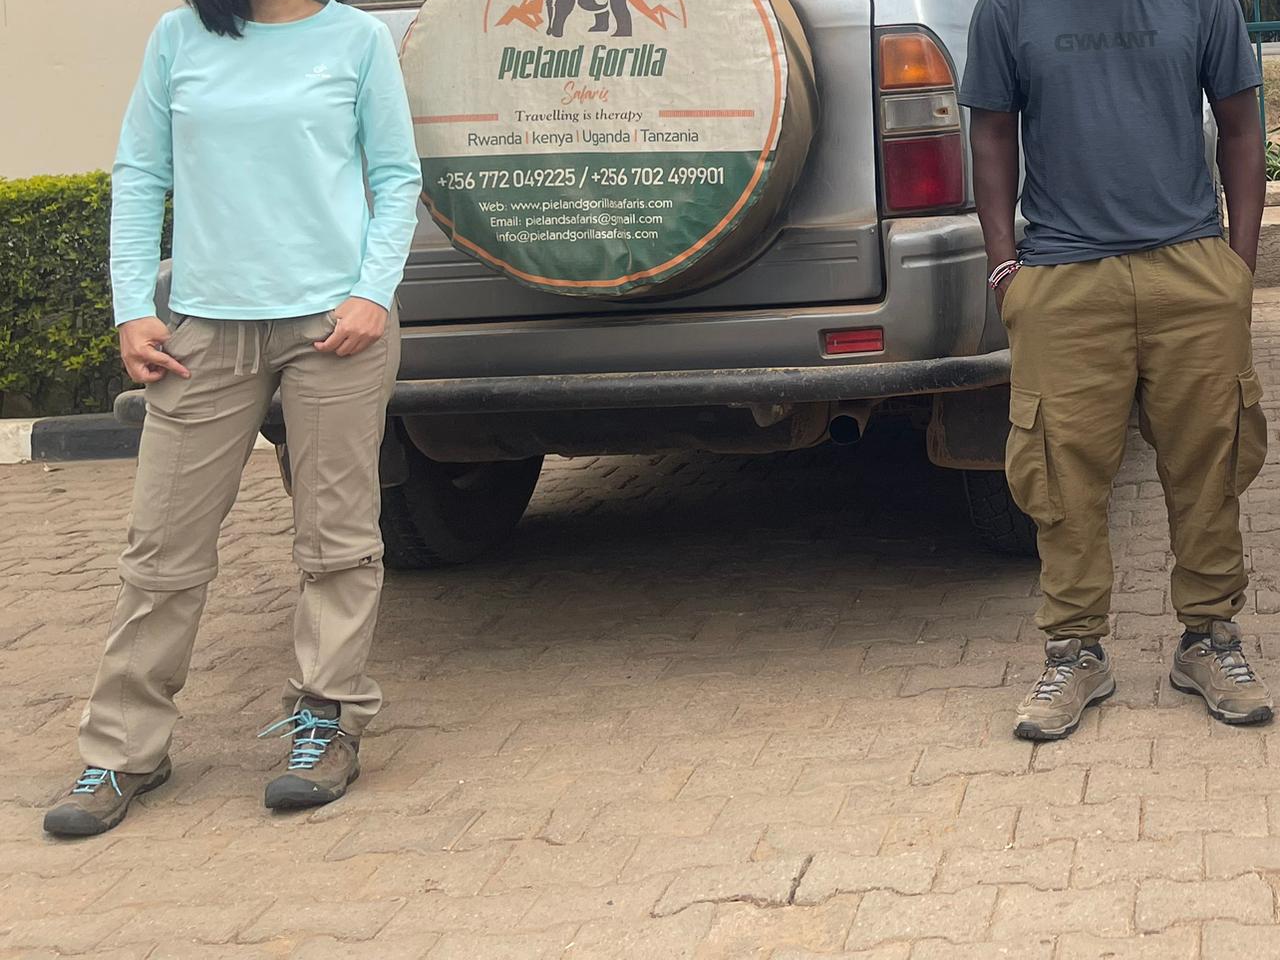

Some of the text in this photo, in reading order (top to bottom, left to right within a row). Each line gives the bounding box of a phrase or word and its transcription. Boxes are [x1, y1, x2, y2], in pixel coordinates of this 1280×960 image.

[498, 44, 668, 81] Pieland Gorilla
[561, 81, 609, 105] Safaris
[515, 109, 643, 122] Travelling is therapy
[468, 129, 699, 147] Rwanda kenya Uganda Tanzania
[437, 172, 475, 190] +256
[480, 170, 510, 189] 772
[513, 168, 575, 188] 049225
[591, 168, 627, 186] +256
[632, 167, 664, 186] 702
[668, 167, 724, 185] 499901
[479, 199, 673, 212] Web: www.pielandgorillasafaris.com
[490, 213, 663, 227] Email: pielandsafaris@gmail.com
[496, 229, 658, 243] info@pielandgorillasafaris.com
